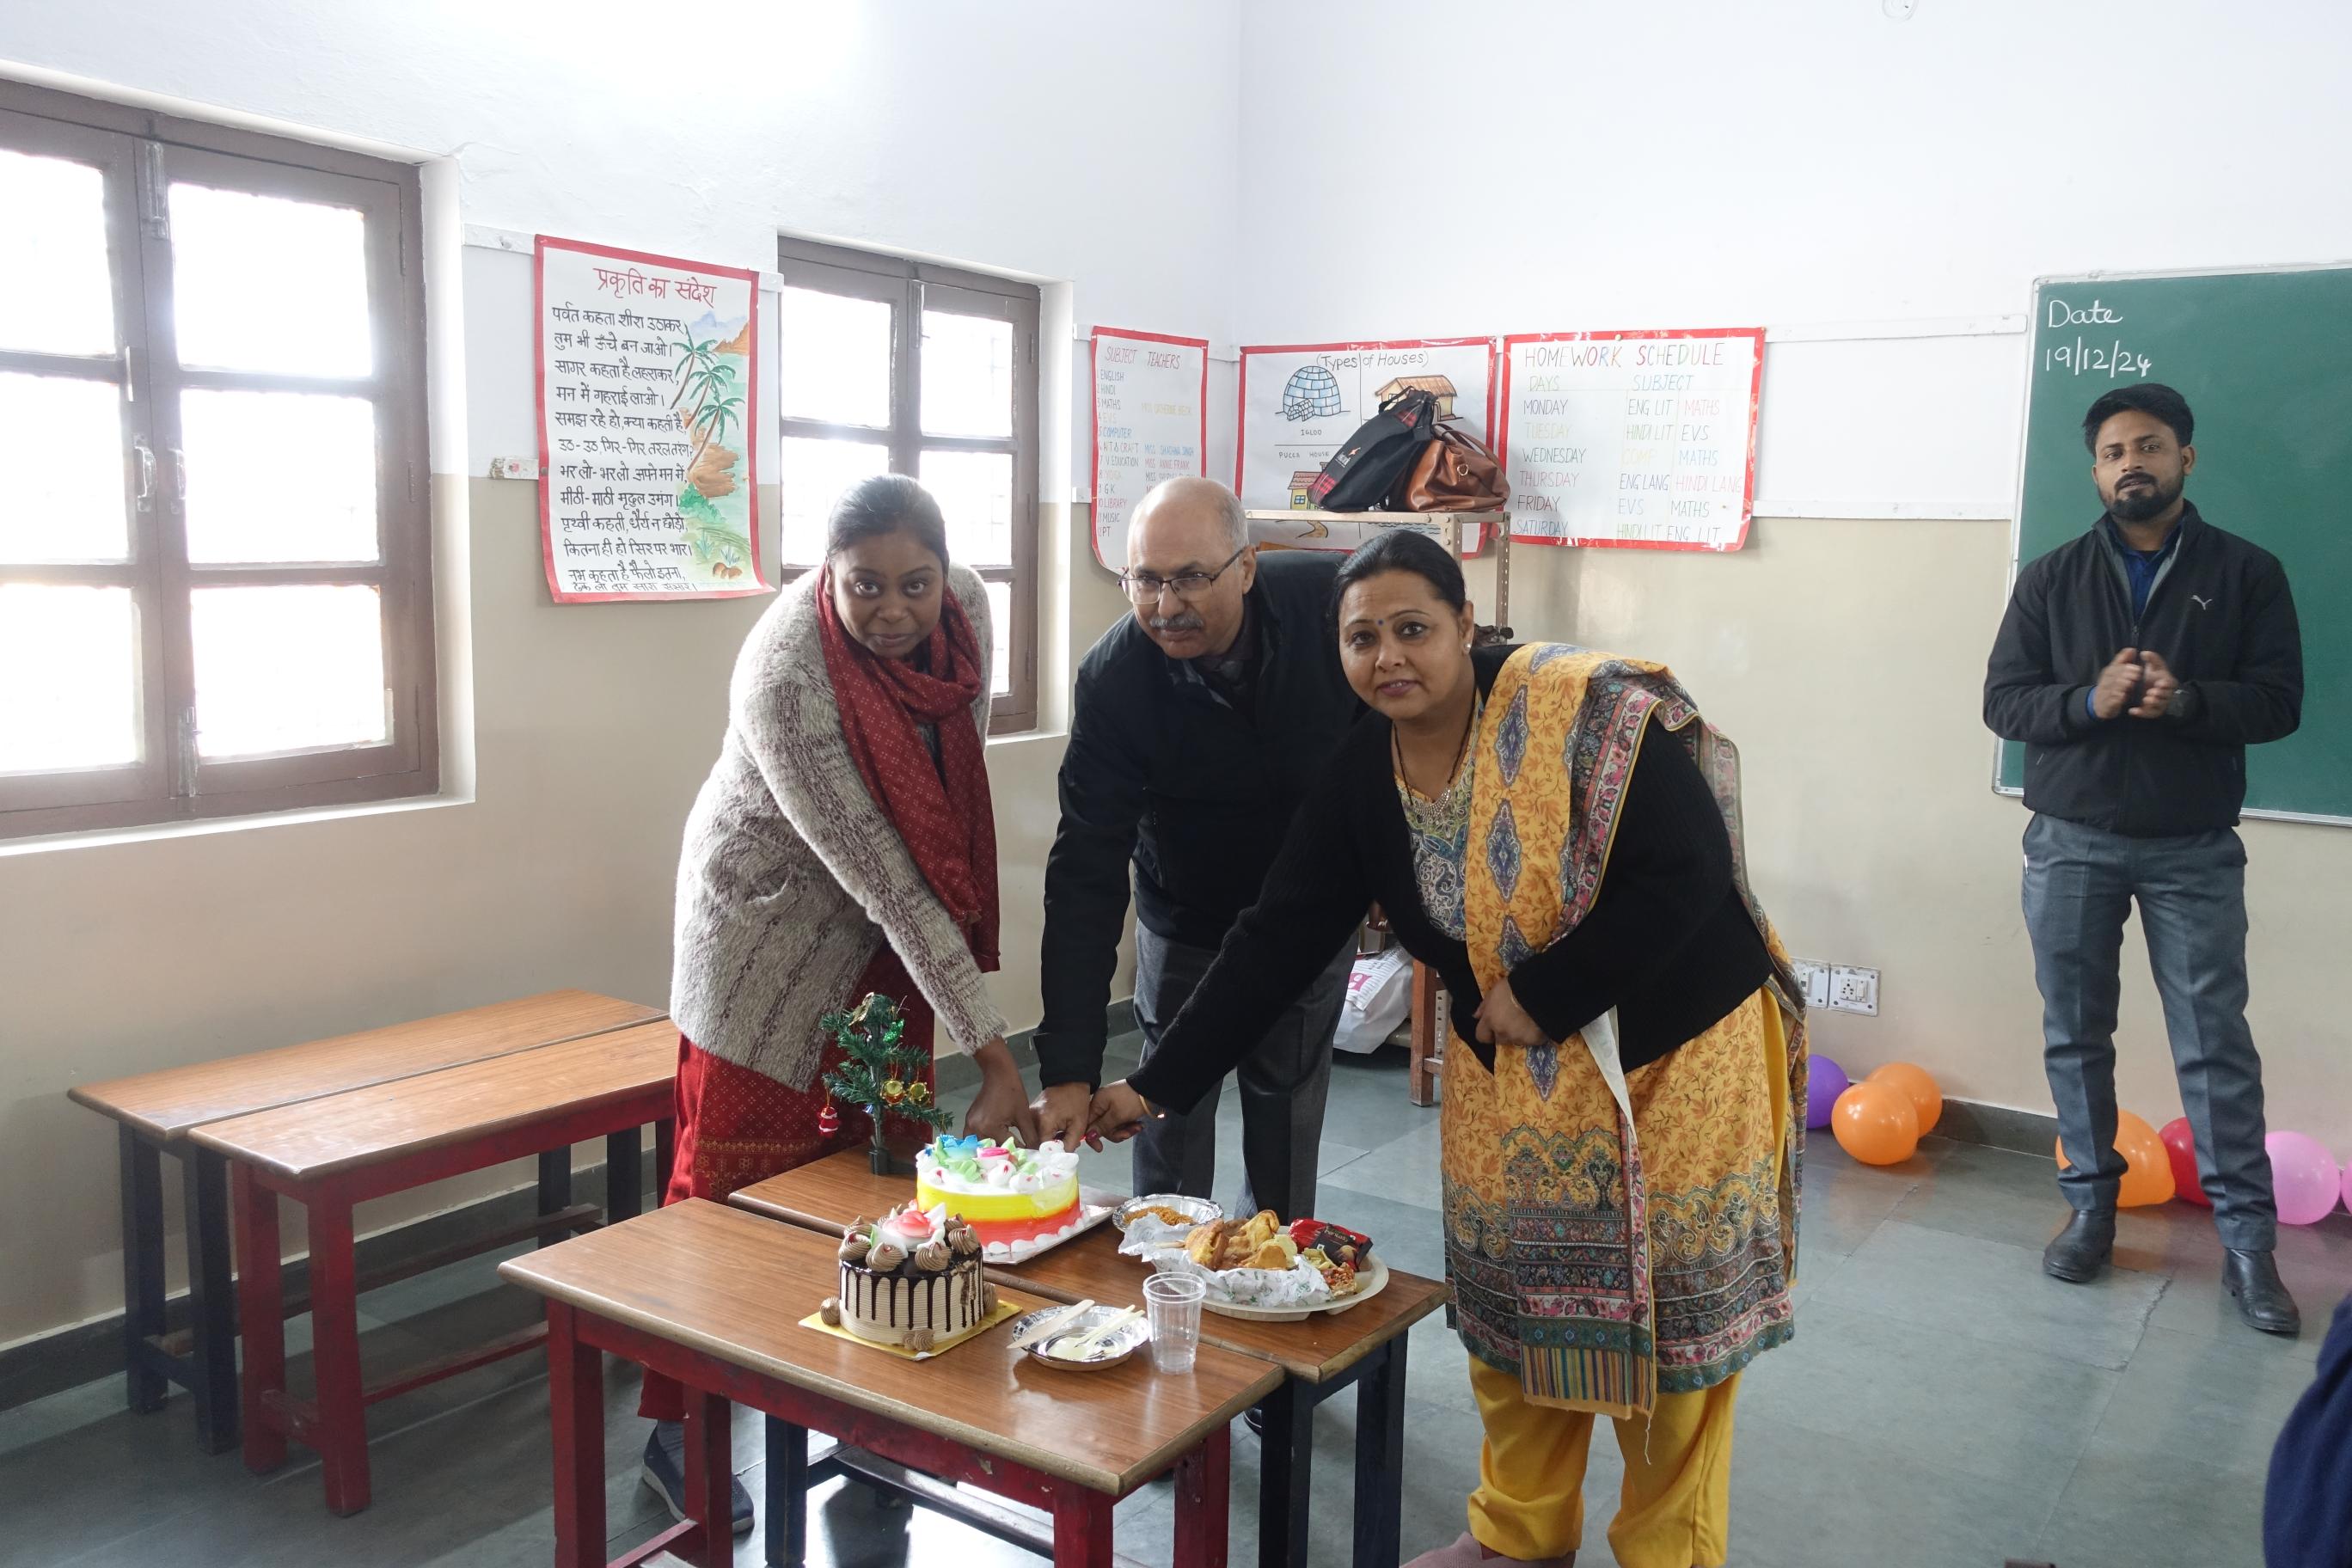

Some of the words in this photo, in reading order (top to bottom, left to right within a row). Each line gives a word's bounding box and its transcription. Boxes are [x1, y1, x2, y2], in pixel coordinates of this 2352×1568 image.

[592, 268, 647, 298] प्रकृति
[648, 278, 671, 298] का
[674, 276, 718, 309] संदेश
[552, 302, 579, 322] पर्वत
[583, 310, 615, 326] कहता
[2048, 299, 2123, 328] Date
[554, 333, 573, 350] तुम
[577, 329, 590, 348] भी
[622, 340, 638, 352] बन
[1106, 346, 1138, 364] SUBJECT
[1148, 352, 1181, 370] TEACHERS
[1363, 354, 1375, 365] of
[1525, 346, 1622, 368] HOMEWORK
[1637, 342, 1725, 366] SCHEDULE
[2046, 336, 2152, 378] 19/12/24
[554, 360, 587, 377] सागर
[590, 363, 620, 379] कहता
[619, 356, 632, 380] है
[1100, 370, 1124, 382] ENGLISH
[1101, 384, 1116, 395] HINDI
[1528, 376, 1560, 392] DAYS
[1632, 375, 1694, 391] SUBJECT
[556, 386, 576, 401] मन
[580, 382, 590, 402] में
[593, 385, 628, 407] गहराई
[1101, 398, 1121, 410] MATHS
[1523, 399, 1568, 415] MONDAY
[1628, 399, 1651, 415] ENG
[1655, 399, 1674, 415] LIT
[1685, 399, 1719, 416] MATHS
[554, 412, 587, 426] समझ
[590, 408, 607, 428] रहे
[623, 416, 645, 429] क्या
[647, 414, 673, 433] कहती
[1103, 426, 1132, 438] COMPUTER
[1526, 422, 1571, 439] TUESDAY
[1626, 425, 1651, 440] HINDI
[1655, 425, 1675, 440] LIT
[1681, 425, 1710, 441] EVS
[648, 442, 670, 456] तरल
[1522, 447, 1587, 463] WEDNESDAY
[1679, 449, 1719, 467] MATHS
[560, 465, 579, 479] भर
[600, 467, 617, 481] भर
[616, 461, 629, 481] लो
[633, 462, 658, 481] अपने
[658, 468, 673, 481] मन
[1112, 456, 1139, 467] EDUCATION
[1145, 458, 1155, 469] MISS
[1173, 459, 1190, 470] FRANK
[1146, 471, 1155, 481] MISS
[1520, 471, 1580, 487] THURSDAY
[1620, 473, 1641, 490] ENG
[1642, 475, 1670, 491] LANG
[1675, 475, 1709, 492] HINDI
[1712, 476, 1743, 493] LANG
[1103, 499, 1127, 509] LIBRARY
[1517, 494, 1561, 512] FRIDAY
[1619, 498, 1644, 515] EVS
[1670, 500, 1710, 518] MATHS
[560, 511, 591, 532] पृथ्वी
[629, 509, 650, 530] धैर्य
[650, 518, 661, 531] न
[1102, 513, 1120, 523] MUSIC
[1102, 526, 1111, 537] PT
[1514, 519, 1568, 536] SATURDAY
[1617, 524, 1642, 539] HINDI
[1645, 524, 1663, 540] LIT
[1667, 525, 1691, 542] ENG
[1698, 527, 1721, 542] LIT
[564, 538, 600, 557] कितना
[602, 538, 612, 555] ही
[616, 537, 627, 555] हो
[568, 569, 585, 582] नभ
[618, 560, 629, 580] है
